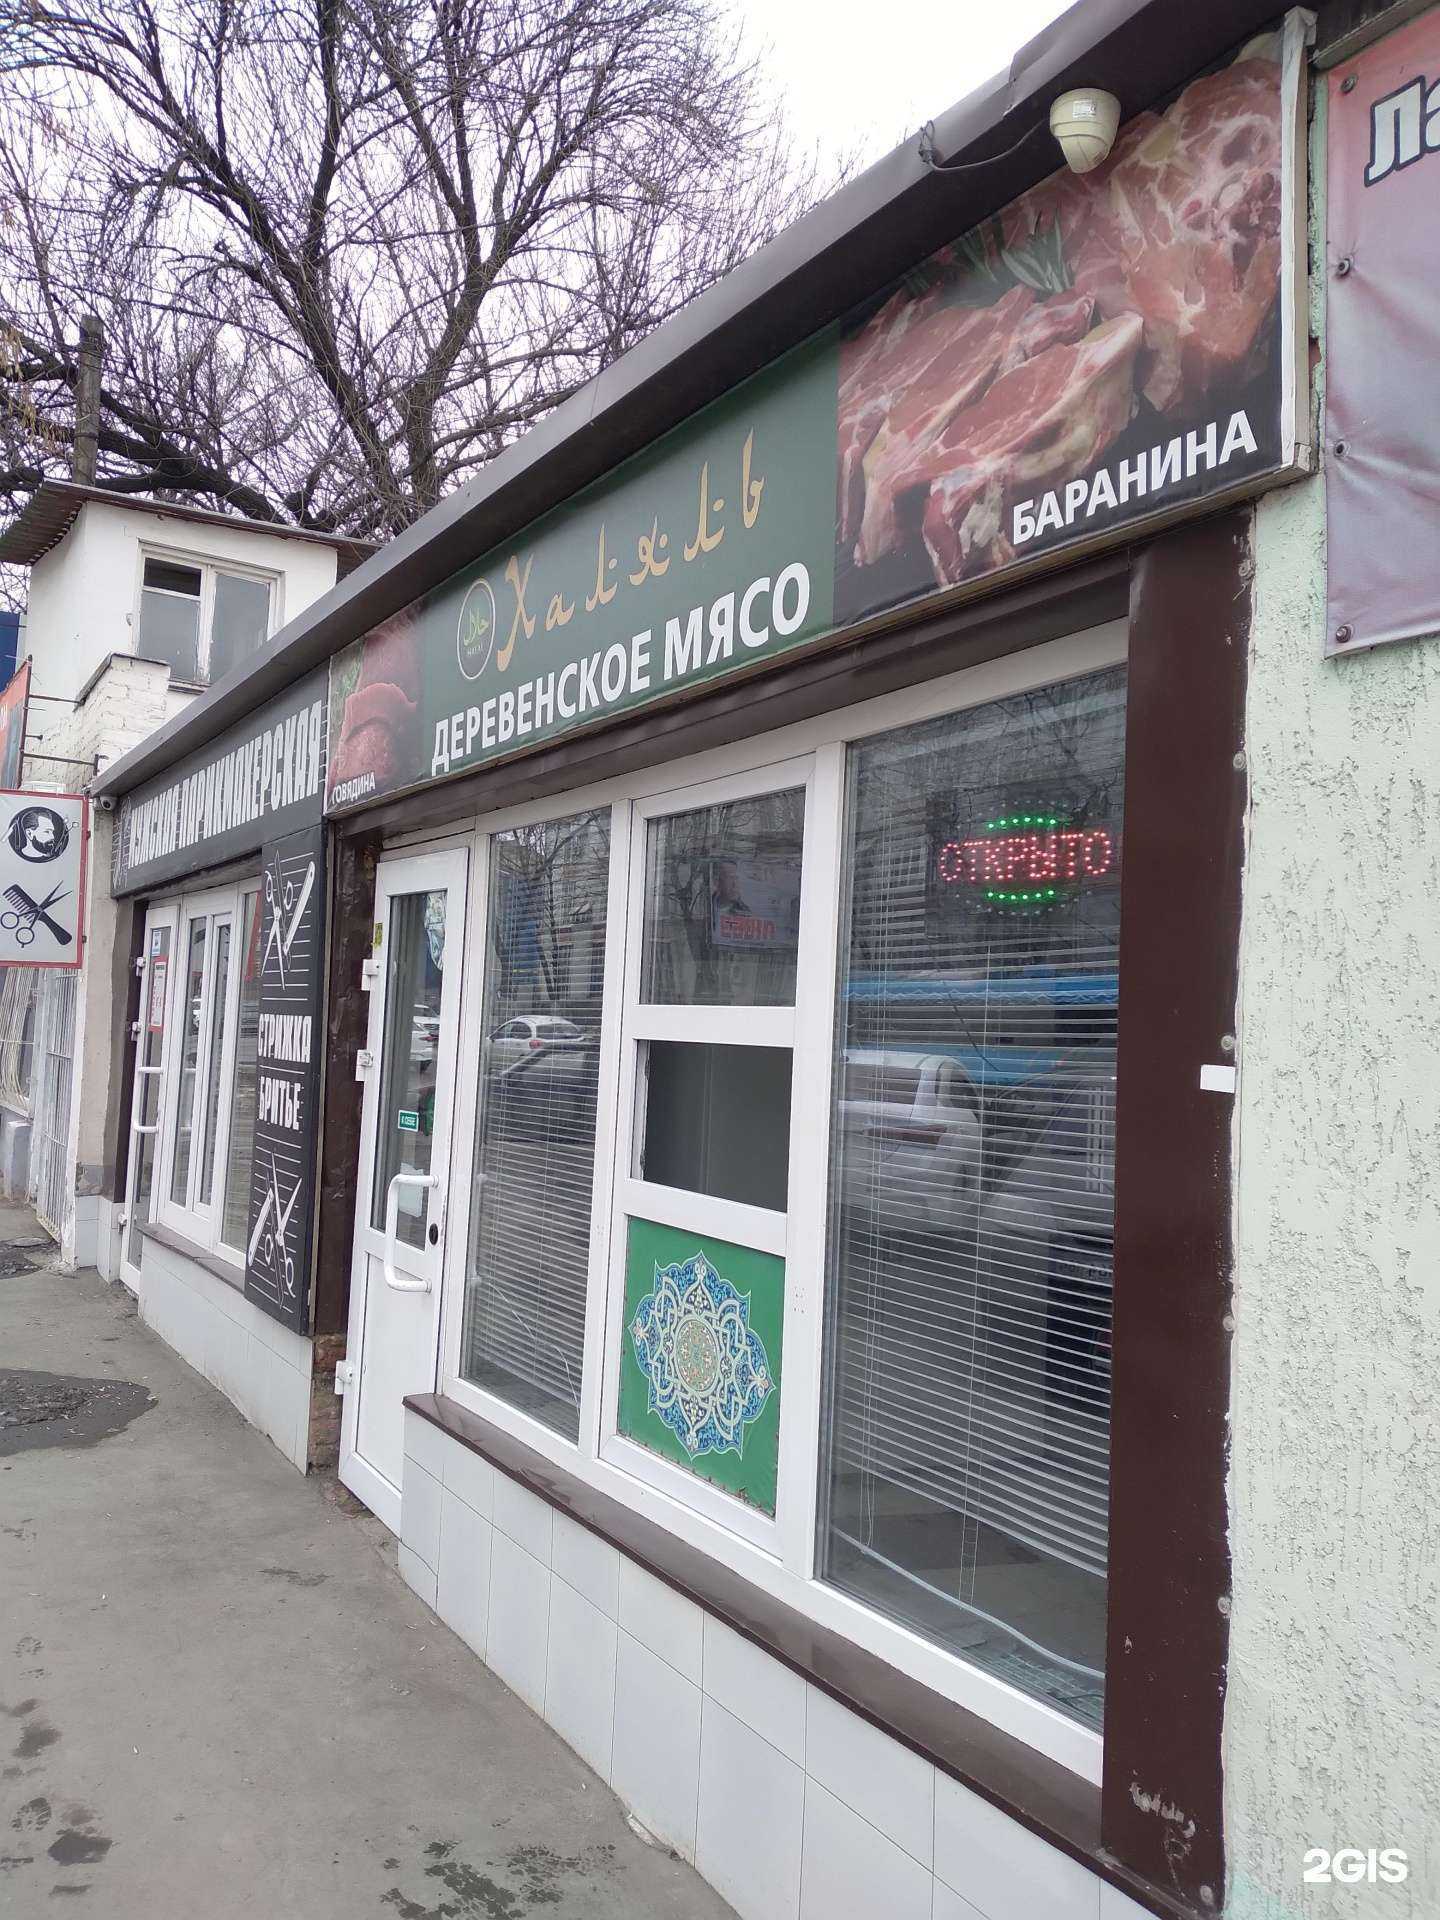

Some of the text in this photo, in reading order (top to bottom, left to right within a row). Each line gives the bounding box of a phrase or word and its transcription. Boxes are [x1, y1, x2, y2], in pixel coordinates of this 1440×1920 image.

[1013, 409, 1258, 545] БАРАНИНА
[431, 562, 810, 777] ДЕРЕВЕНСКОЕ МЯСО
[128, 700, 322, 869] МУЖСКАЯ ПАРИКМАХЕРСКАЯ
[331, 771, 376, 805] ГОВЯДИНА
[939, 830, 1112, 881] ОТКРЫТО
[258, 1013, 312, 1064] СТРИЖКА
[259, 1075, 301, 1131] БРИТЬЕ
